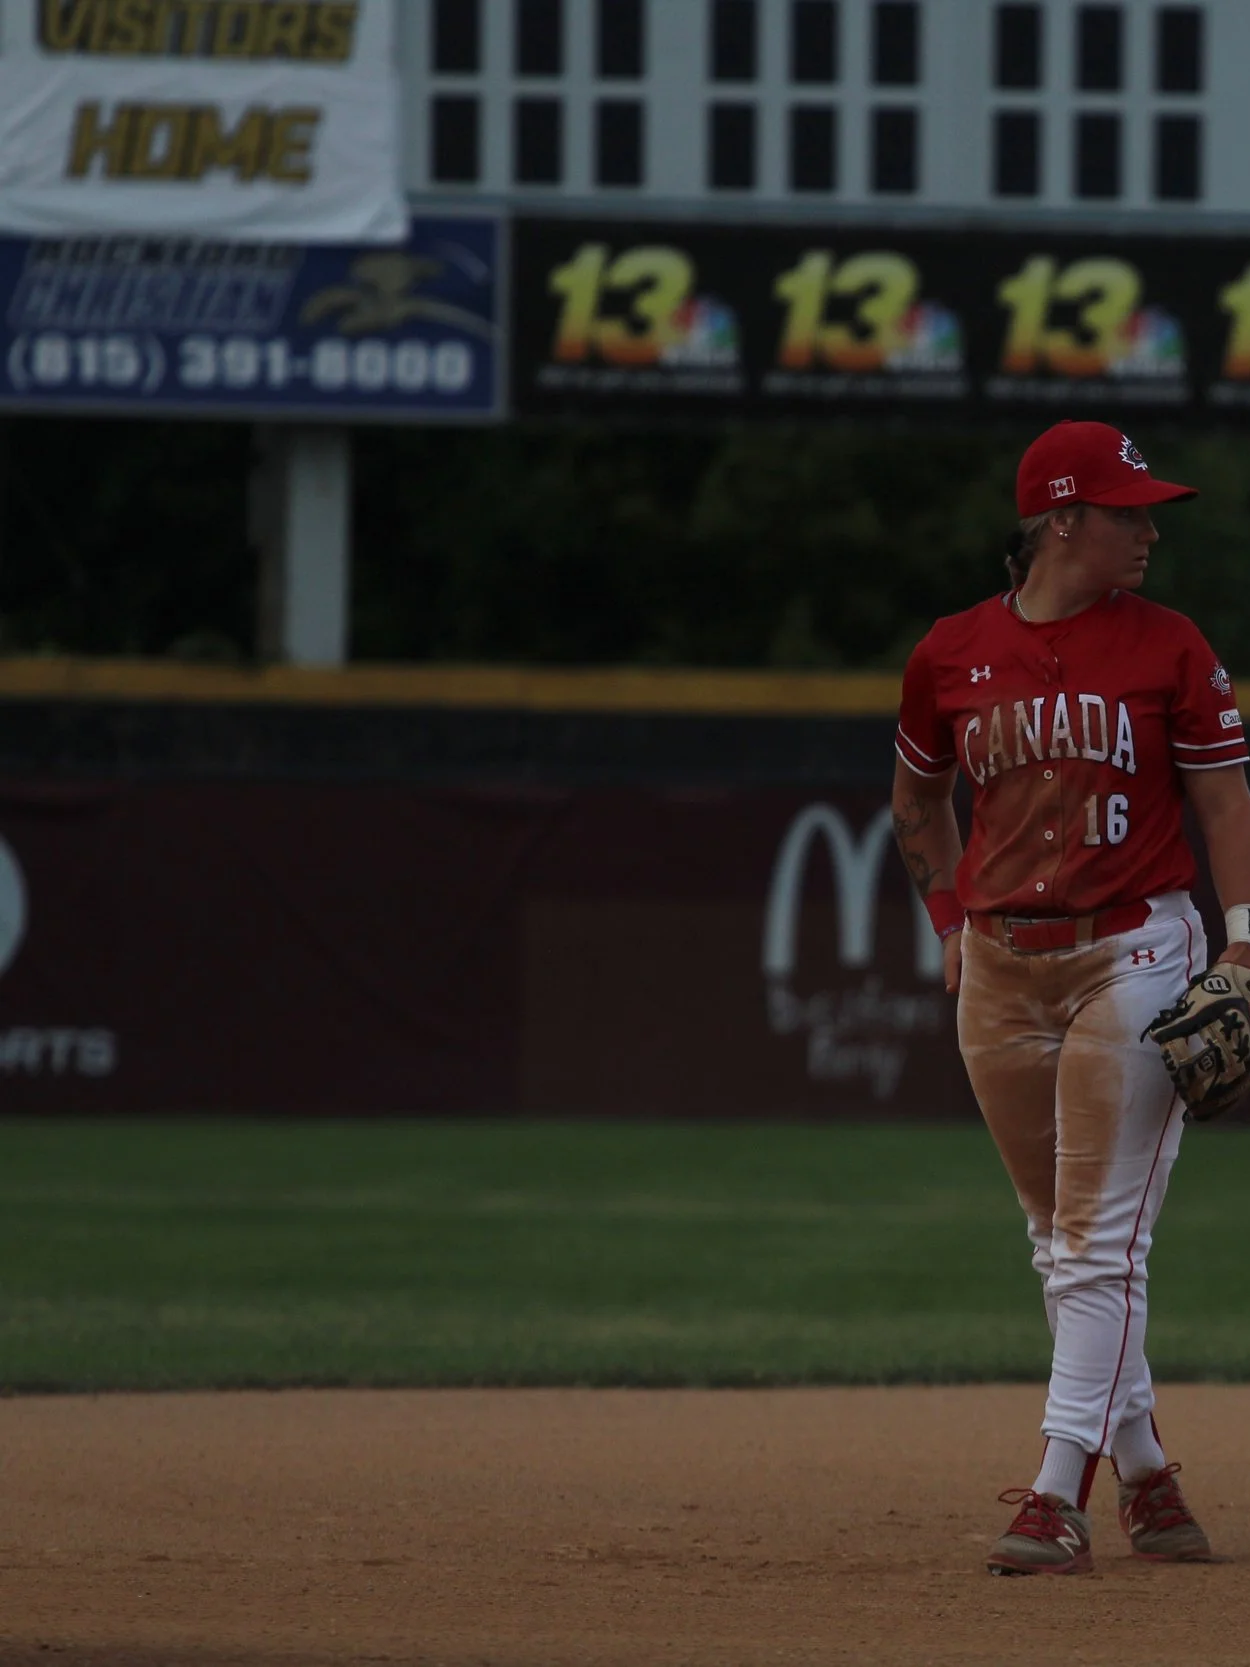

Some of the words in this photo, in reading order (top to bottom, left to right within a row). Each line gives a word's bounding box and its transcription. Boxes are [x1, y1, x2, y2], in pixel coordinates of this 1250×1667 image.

[36, 0, 358, 62] VISITORS
[67, 101, 320, 183] HOME
[547, 240, 696, 365] 13
[772, 247, 922, 371] 13
[996, 252, 1145, 376] 13
[964, 691, 1137, 787] CANADA
[1083, 793, 1129, 847] 16
